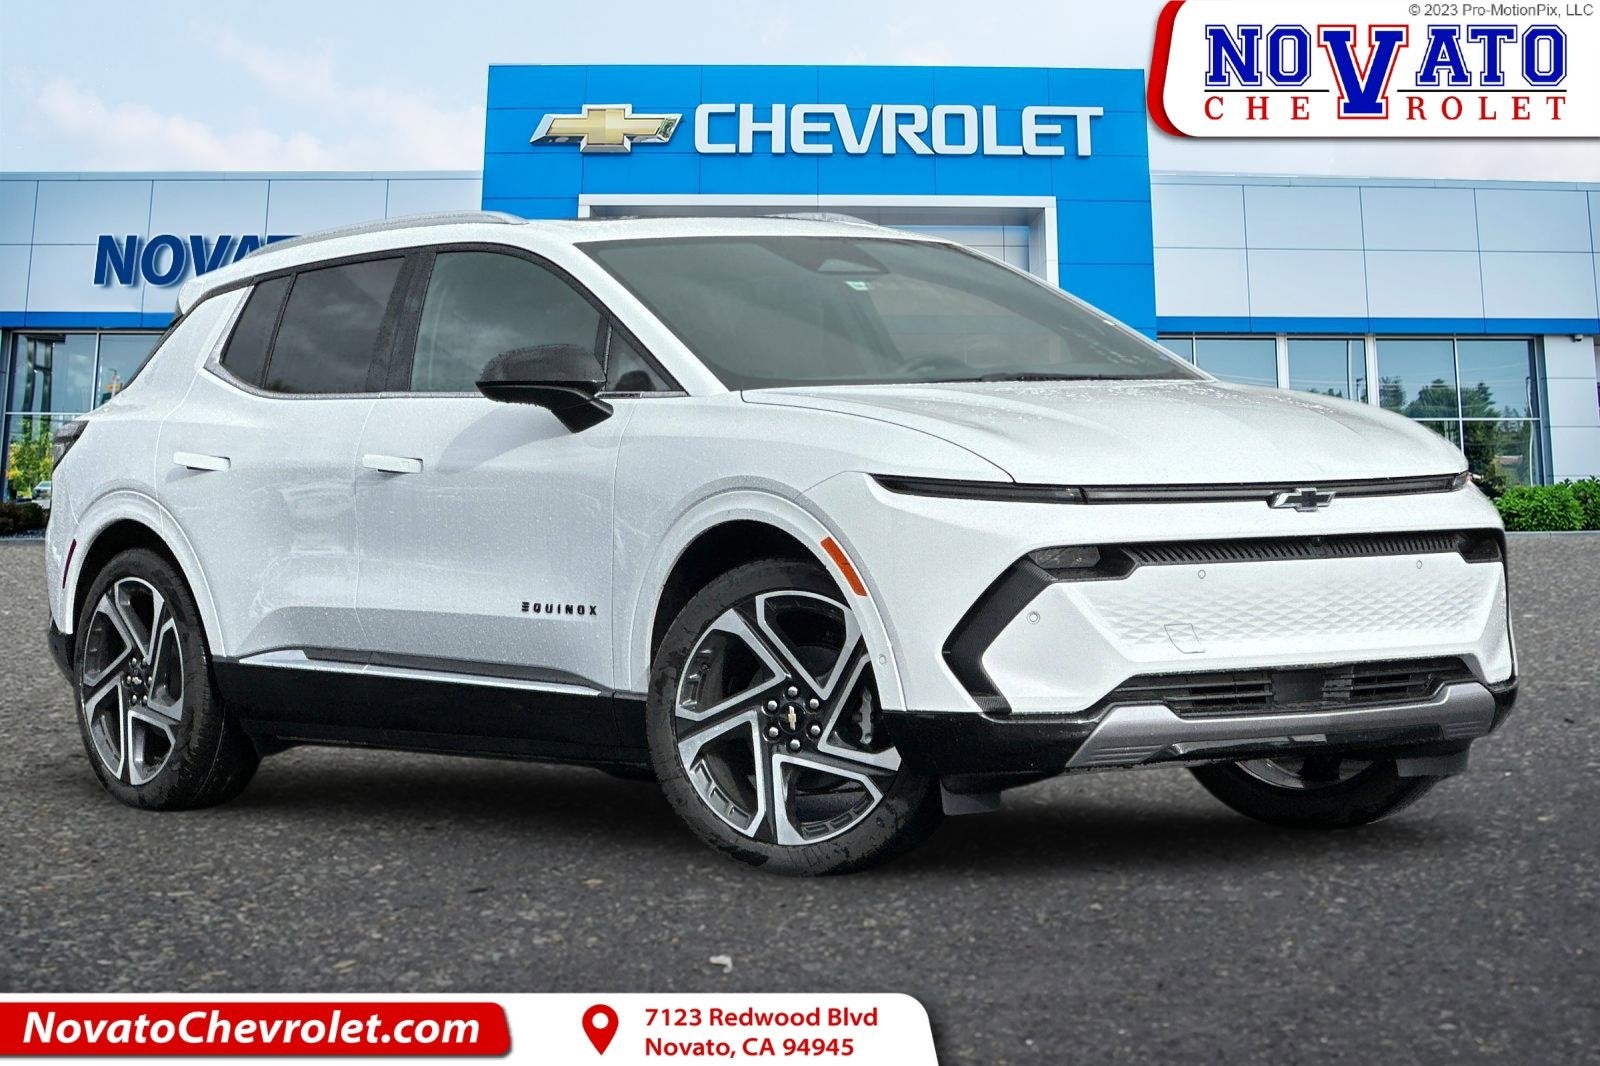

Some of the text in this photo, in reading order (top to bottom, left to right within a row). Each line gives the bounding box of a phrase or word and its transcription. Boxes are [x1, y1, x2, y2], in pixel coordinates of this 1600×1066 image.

[694, 103, 1104, 157] CHEVROLET
[93, 234, 301, 286] NOV
[521, 601, 597, 616] EQUINOX
